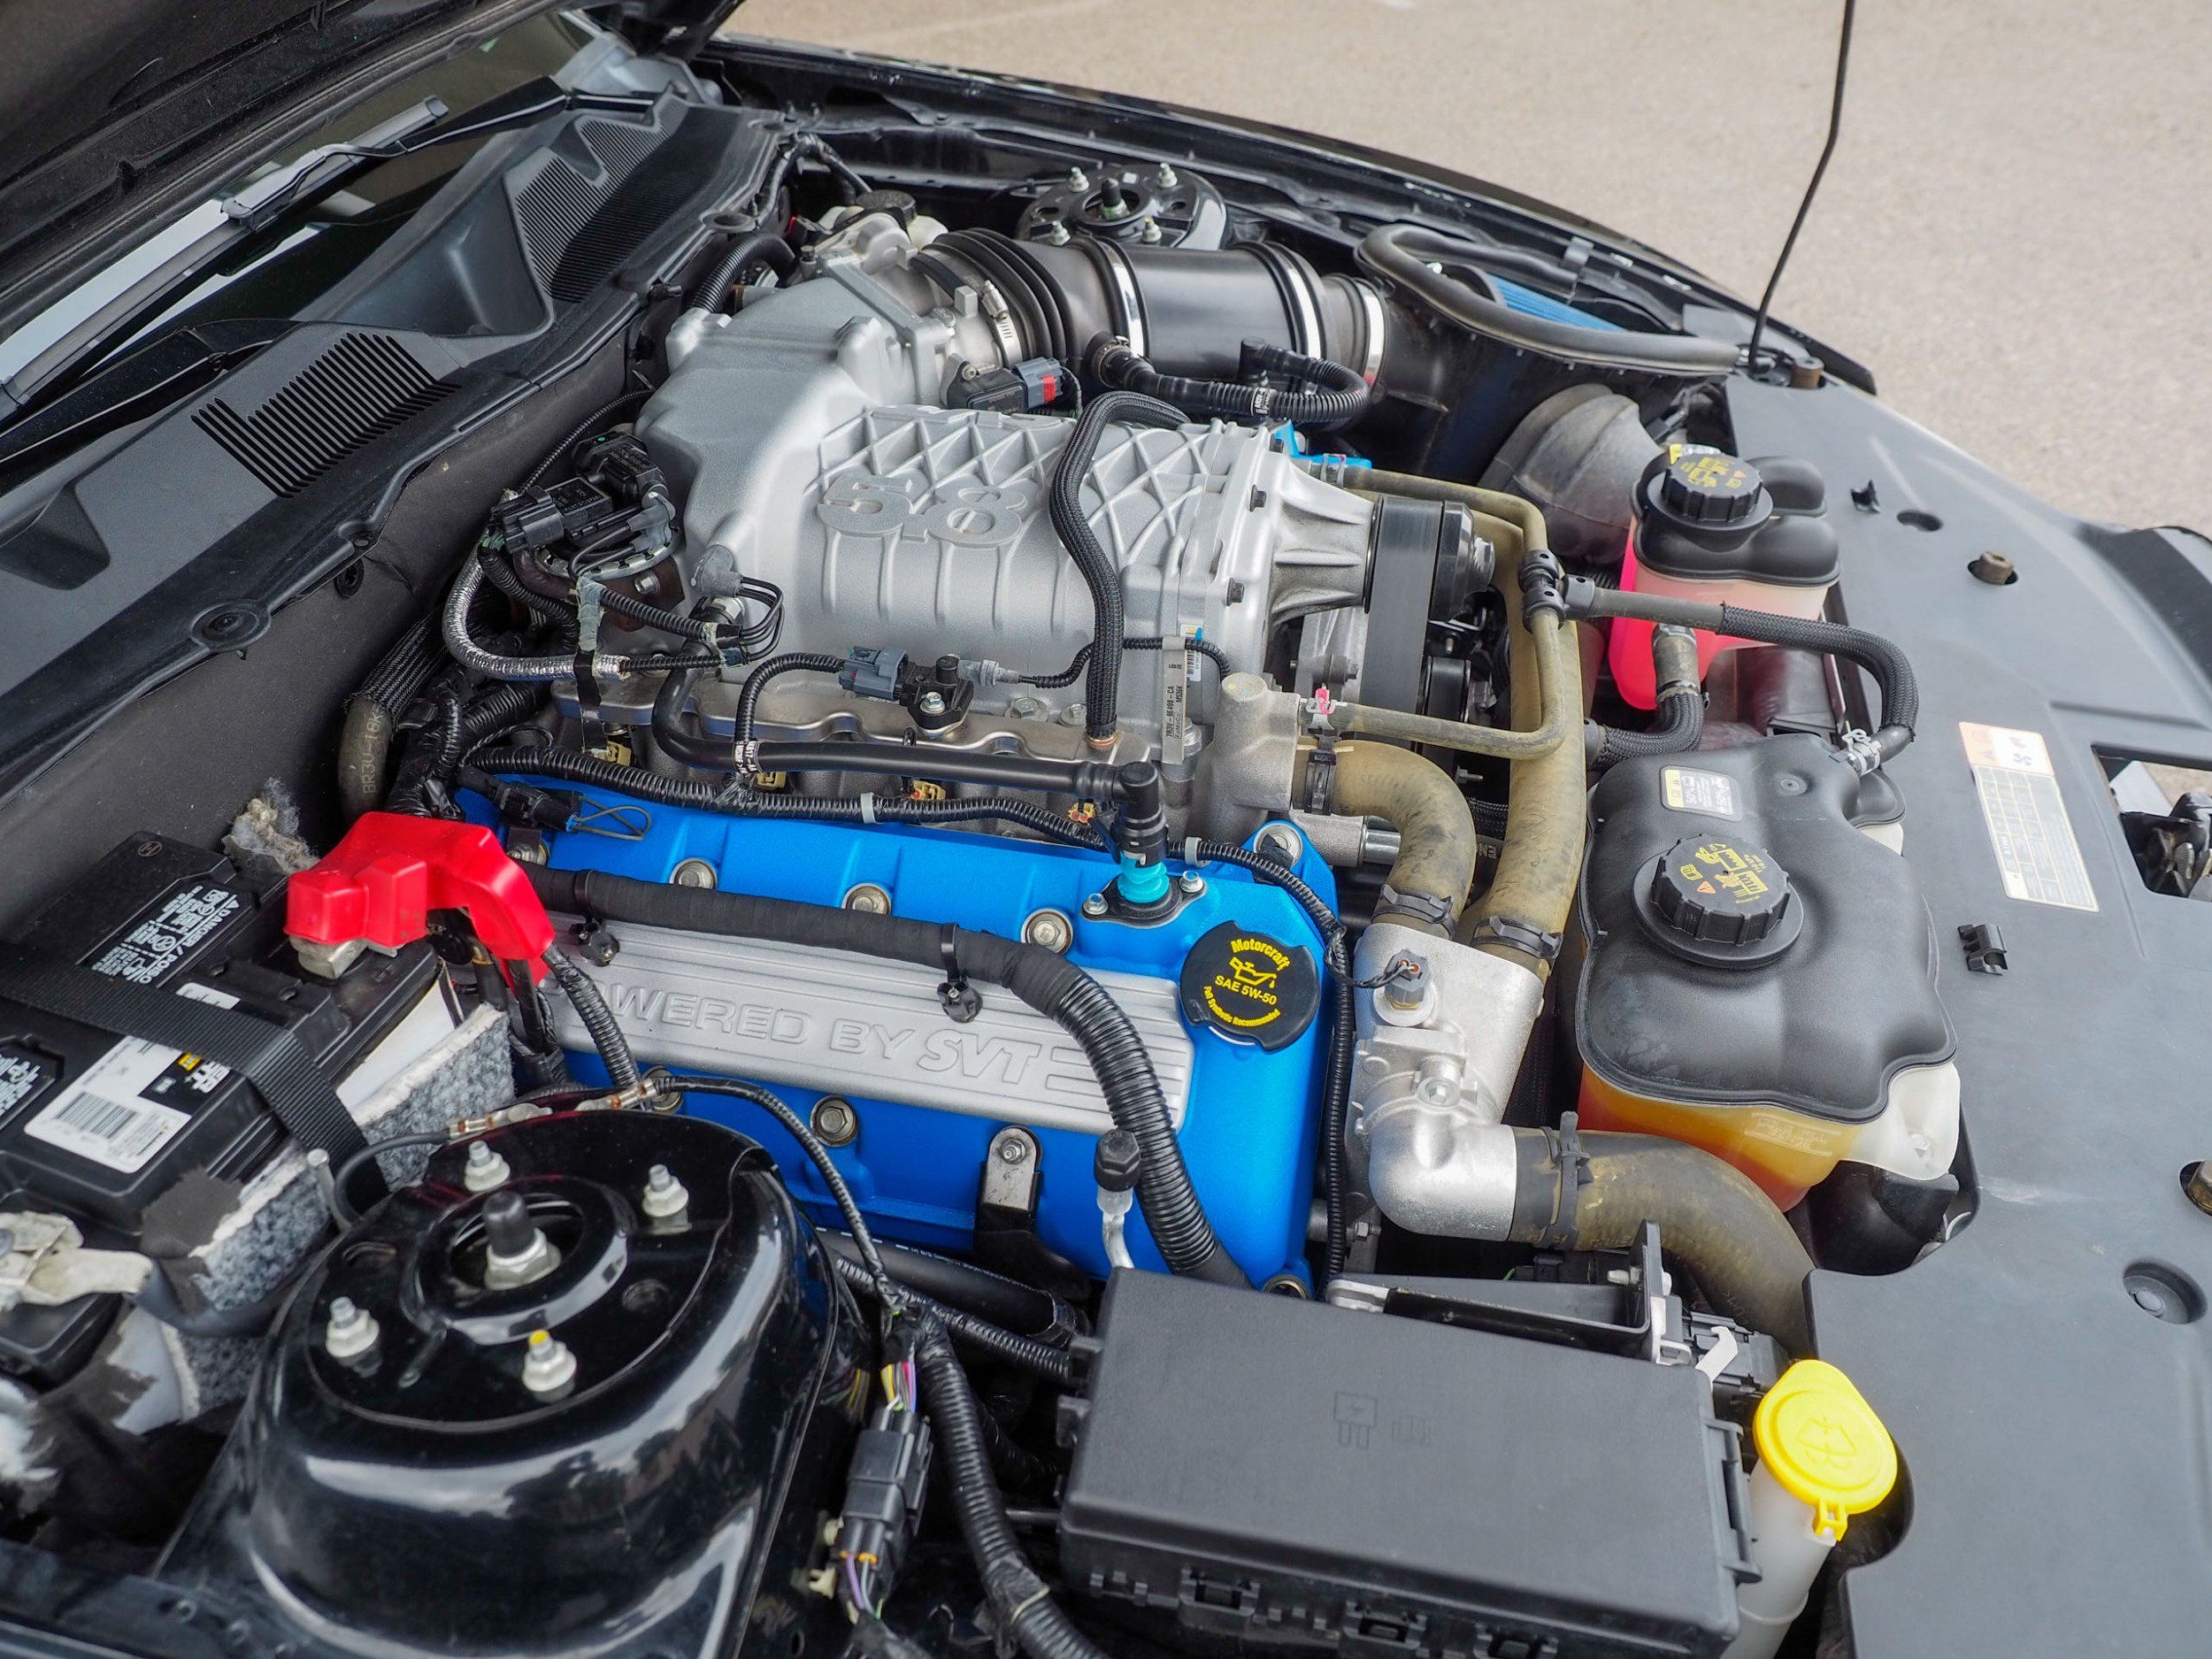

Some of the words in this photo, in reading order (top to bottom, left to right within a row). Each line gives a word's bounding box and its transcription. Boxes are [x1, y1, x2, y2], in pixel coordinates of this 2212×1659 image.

[182, 909, 232, 947] DANGER
[139, 953, 179, 984] POISO
[1231, 938, 1291, 972] Motorcraft
[1215, 975, 1241, 993] SAE
[1240, 985, 1278, 1005] 5W-50
[1208, 998, 1233, 1023] Synthetic
[829, 1018, 918, 1060] BY
[917, 1028, 1042, 1085] SVT
